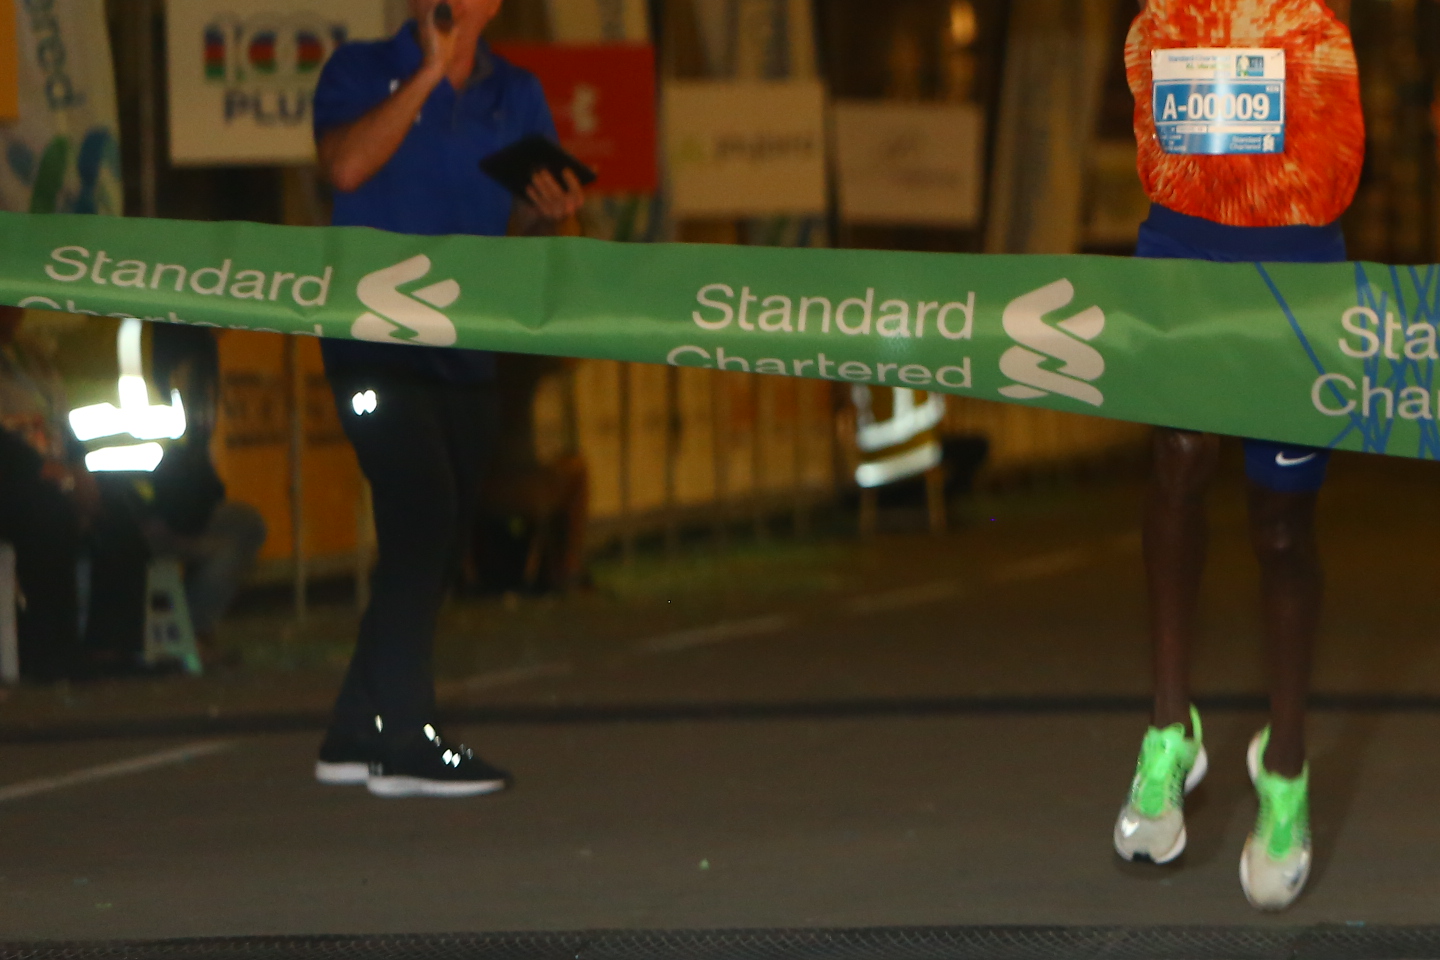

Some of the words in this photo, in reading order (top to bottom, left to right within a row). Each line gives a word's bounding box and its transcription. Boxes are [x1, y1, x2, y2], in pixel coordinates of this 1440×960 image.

[224, 91, 314, 125] PLU
[1162, 93, 1270, 120] A-00009
[44, 245, 333, 307] Standard
[692, 283, 975, 340] Standard
